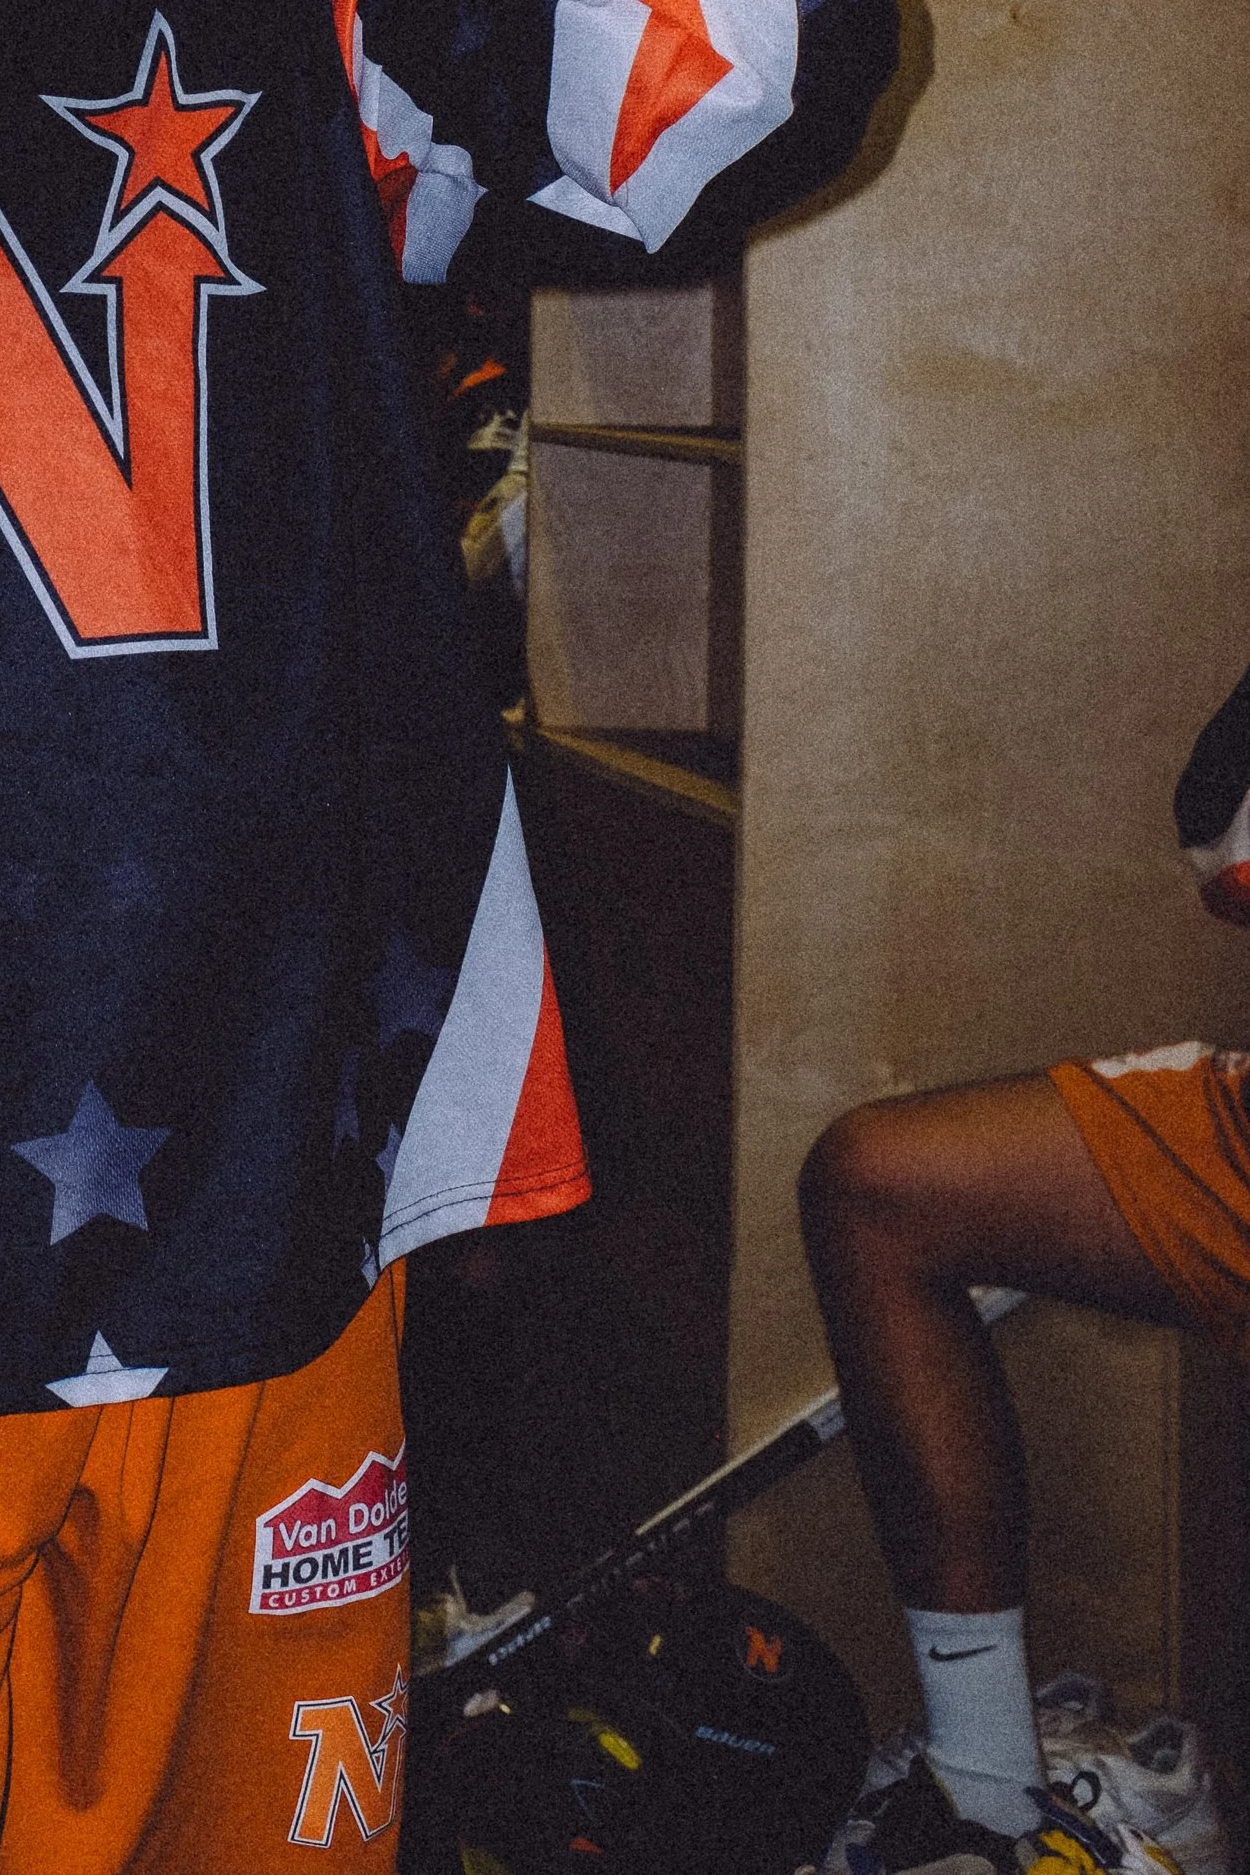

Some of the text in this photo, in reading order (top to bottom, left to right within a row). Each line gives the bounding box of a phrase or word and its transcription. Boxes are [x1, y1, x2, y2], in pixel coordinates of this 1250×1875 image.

[278, 1478, 408, 1551] Van Dolde
[261, 1540, 374, 1590] HOME
[268, 1579, 357, 1608] CUSTOM
[745, 1626, 783, 1674] N
[288, 1695, 406, 1849] N
